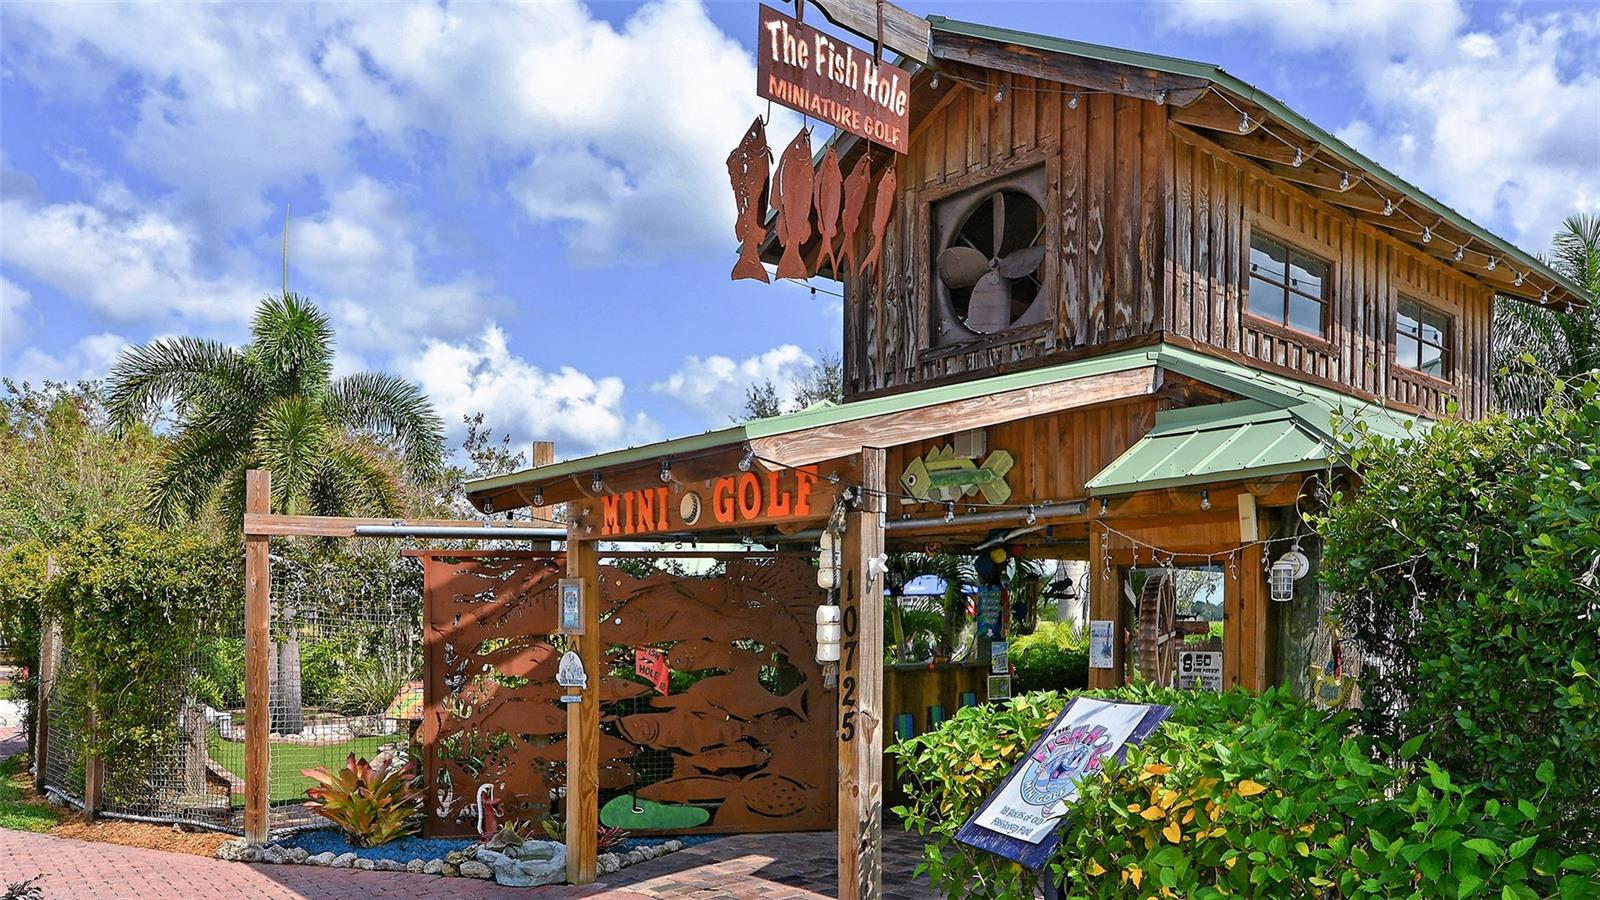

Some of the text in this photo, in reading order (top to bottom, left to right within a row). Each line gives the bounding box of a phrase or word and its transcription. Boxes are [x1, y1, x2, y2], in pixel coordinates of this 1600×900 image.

[764, 20, 908, 117] The Fish Hole
[769, 73, 902, 146] MINIATURE GOLF
[601, 465, 818, 536] MINI GOLF
[639, 664, 660, 681] HOLE
[841, 569, 858, 742] 10725
[1182, 653, 1212, 673] 8.50
[1031, 724, 1091, 764] FISH
[1051, 724, 1072, 737] THE
[1024, 780, 1066, 803] MINI GOLF
